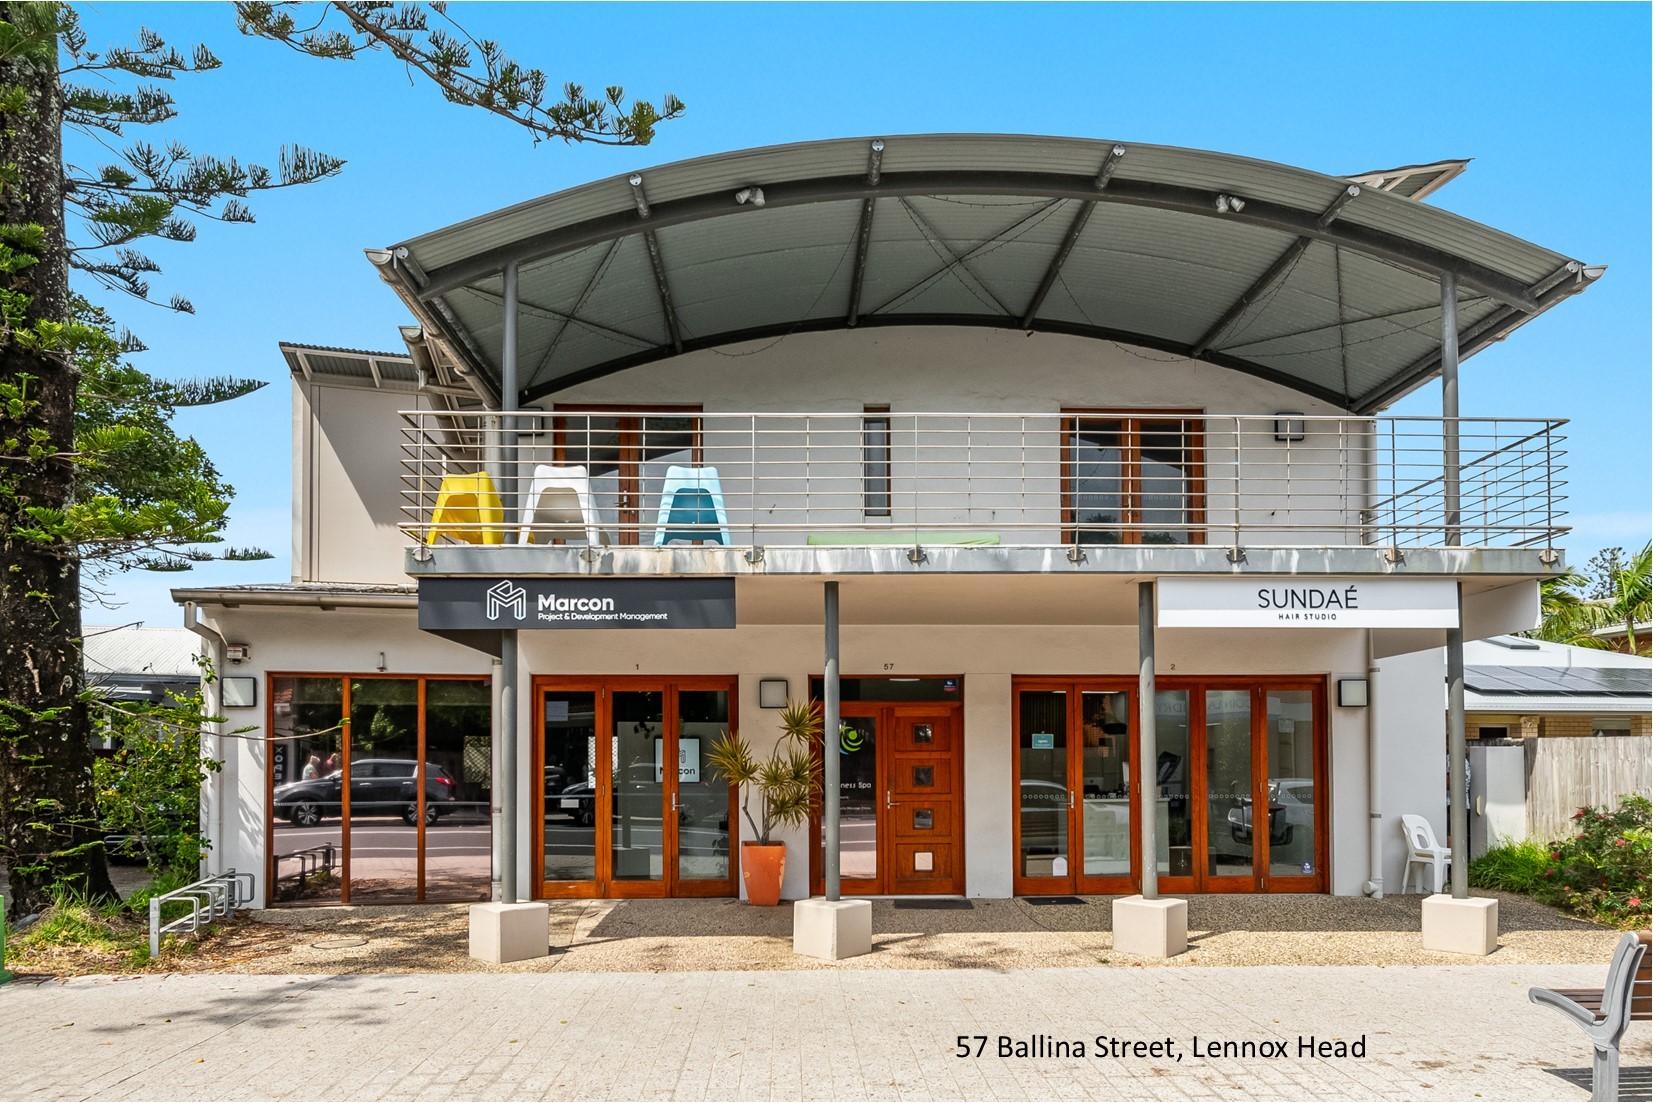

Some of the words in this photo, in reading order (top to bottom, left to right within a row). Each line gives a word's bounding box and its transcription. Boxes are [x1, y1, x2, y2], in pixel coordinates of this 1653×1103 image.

[1258, 585, 1358, 609] SUNDAÉ
[538, 594, 614, 612] Marcon
[538, 612, 563, 622] Project
[564, 613, 570, 621] &
[571, 612, 619, 622] Development
[619, 612, 668, 622] Management
[1278, 613, 1300, 621] HAIR
[1304, 613, 1337, 621] STUDIO
[883, 663, 895, 671] 57
[1170, 663, 1176, 671] 2
[857, 781, 872, 789] Spa
